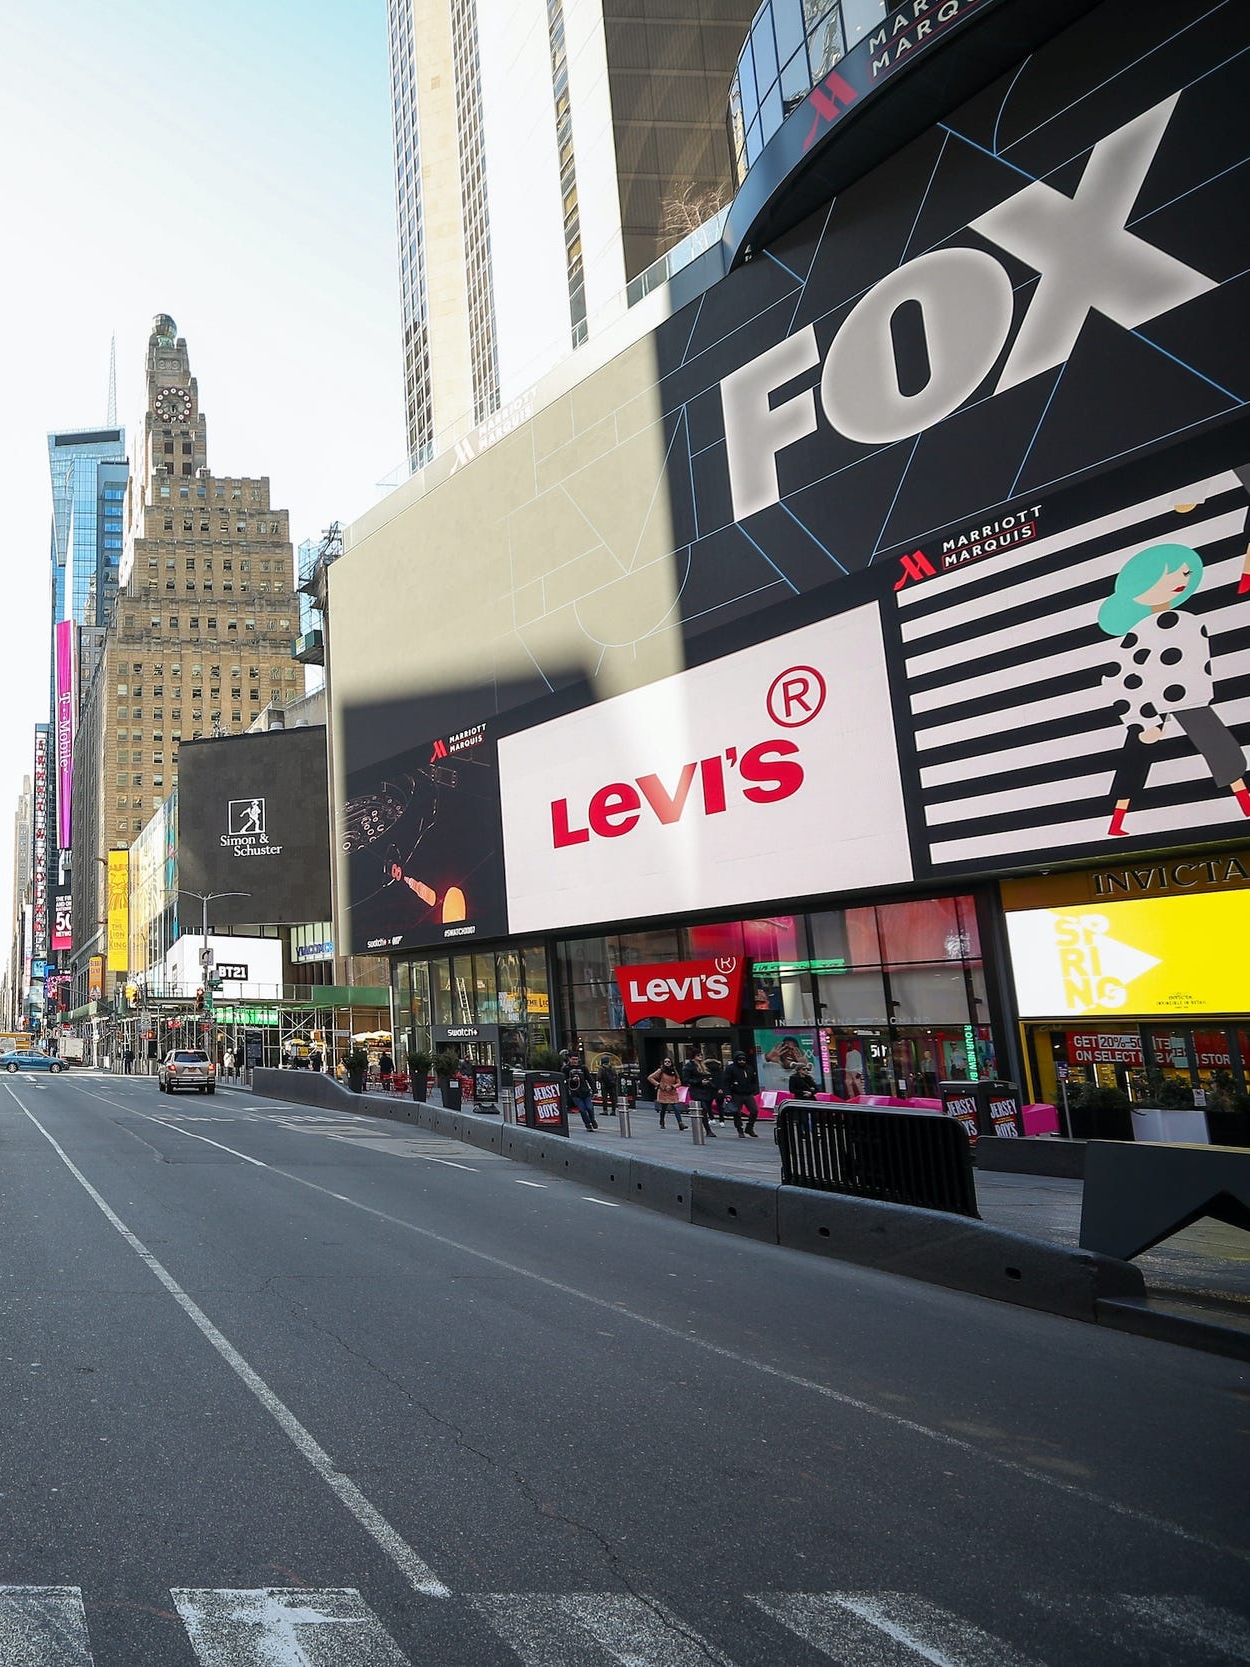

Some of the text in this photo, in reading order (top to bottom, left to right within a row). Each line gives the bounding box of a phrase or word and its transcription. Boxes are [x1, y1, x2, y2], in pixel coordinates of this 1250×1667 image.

[869, 0, 940, 54] MAR
[872, 0, 974, 77] MARQ
[720, 88, 1221, 523] FOX
[478, 386, 539, 438] MARRIOTT
[942, 504, 1042, 553] MARRIOTT
[945, 525, 1032, 567] MARQUIS
[449, 723, 487, 744] MARRIOTT
[450, 735, 483, 753] MARQUIS
[220, 834, 270, 847] Simon &
[234, 845, 283, 857] Schuster
[1095, 857, 1250, 896] INVICTA
[218, 967, 247, 978] BT21
[447, 1028, 475, 1037] swatch
[1073, 1036, 1097, 1048] GET
[1076, 1050, 1137, 1063] ON SELECT
[1201, 1053, 1246, 1065] STORS
[533, 1083, 560, 1100] JERSEY
[537, 1102, 560, 1119] BOYS
[946, 1097, 977, 1116] JERSEY
[990, 1098, 1017, 1118] JERSEY
[961, 1120, 978, 1136] YS
[994, 1121, 1019, 1137] BOYS
